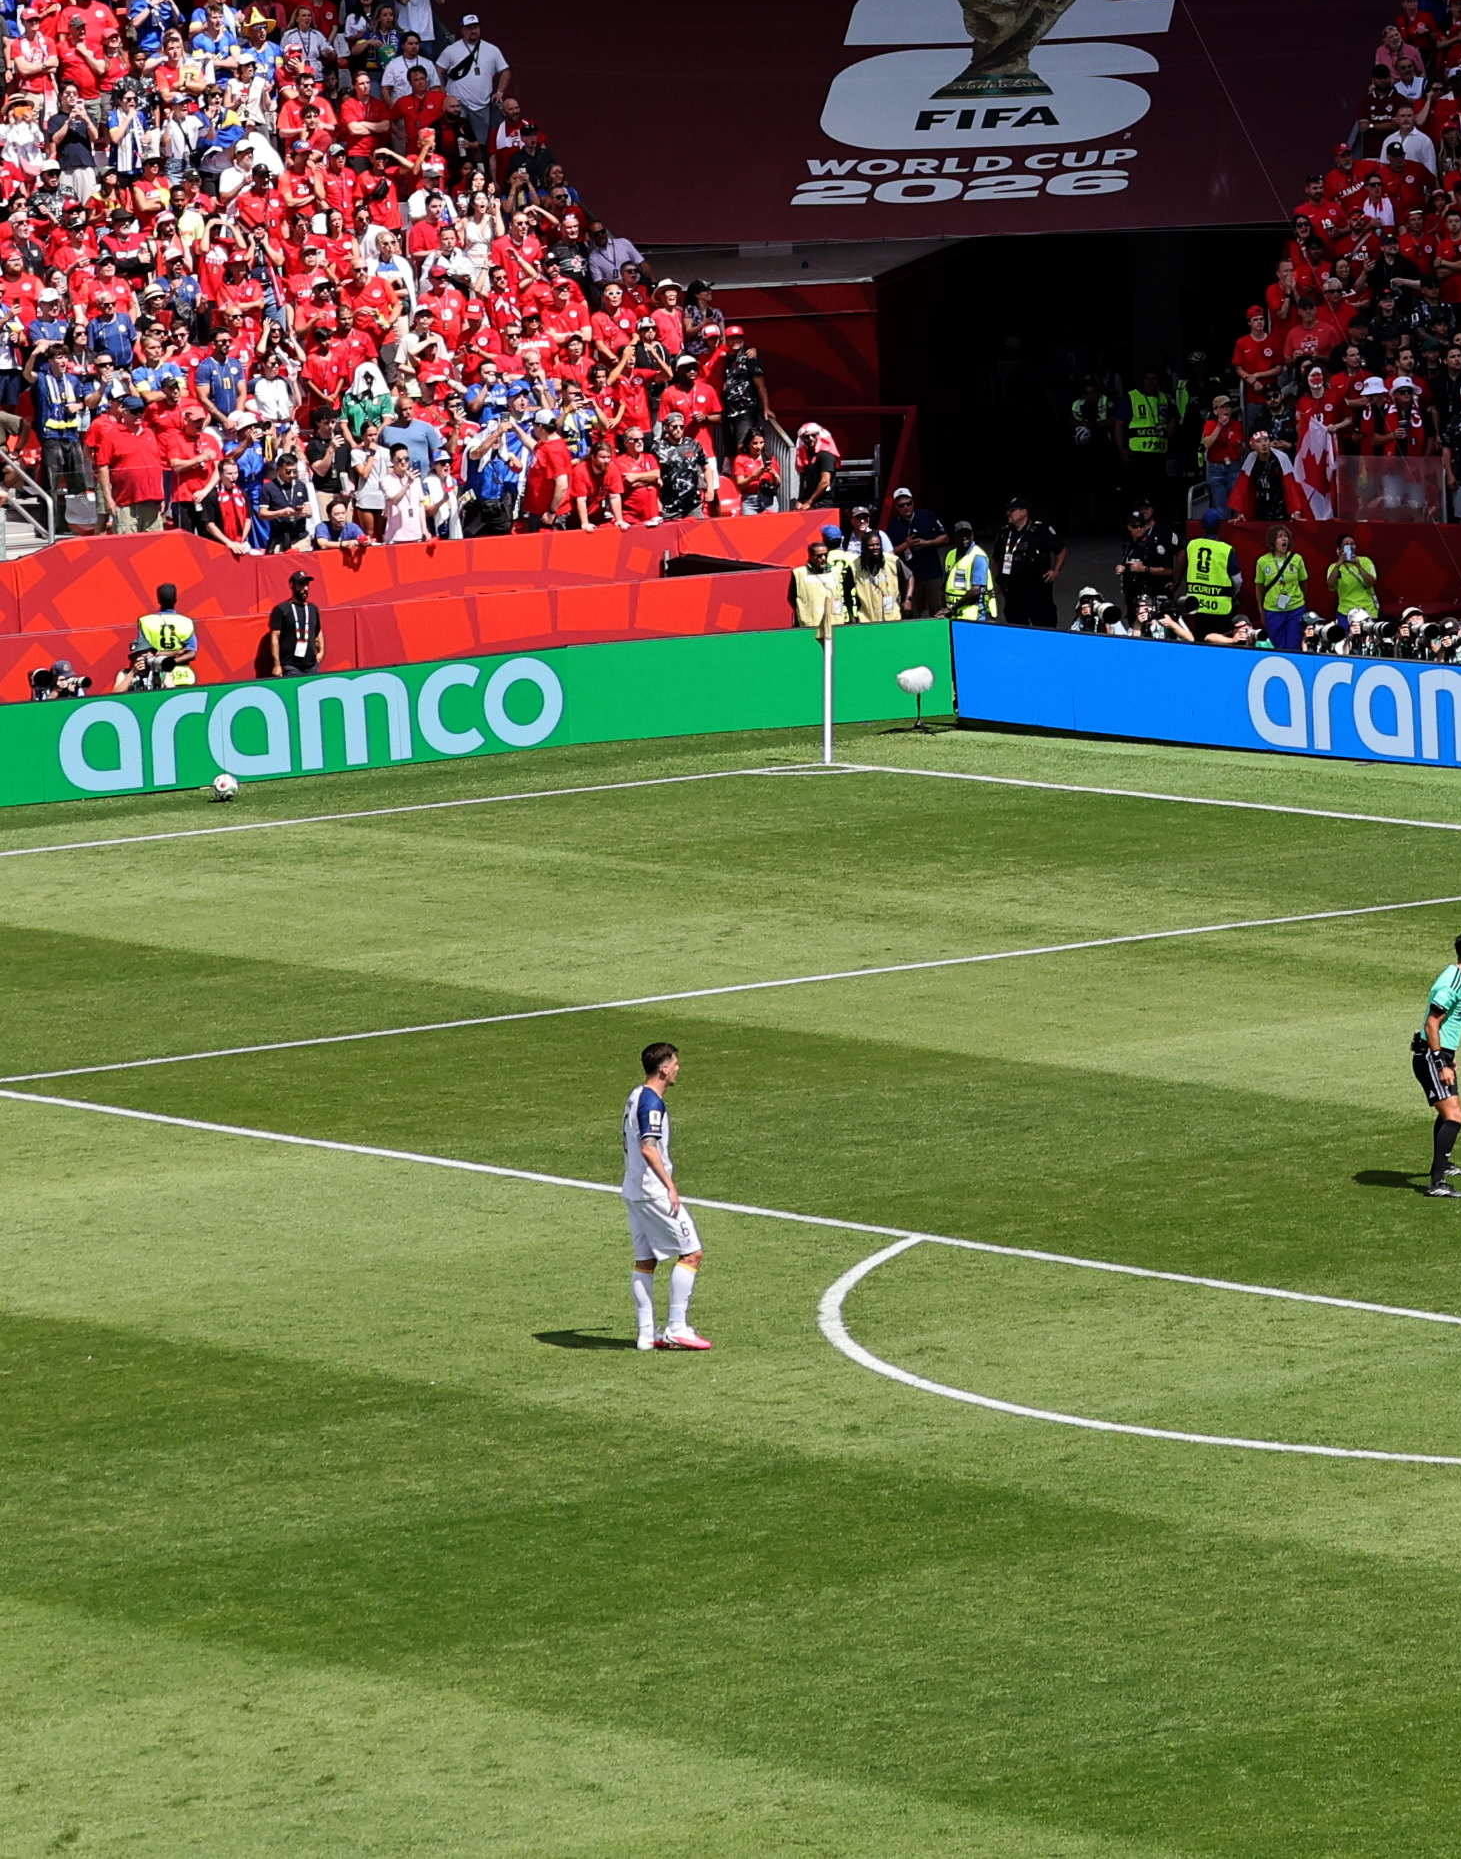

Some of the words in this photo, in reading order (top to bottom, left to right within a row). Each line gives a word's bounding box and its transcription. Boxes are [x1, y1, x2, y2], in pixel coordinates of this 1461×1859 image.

[914, 106, 1060, 131] FIFA
[806, 155, 1013, 176] WORLD
[1024, 148, 1139, 170] CUP
[790, 170, 1131, 205] 2026
[1187, 583, 1223, 596] ECURITY
[59, 658, 564, 792] aramco
[679, 1221, 690, 1238] 6
